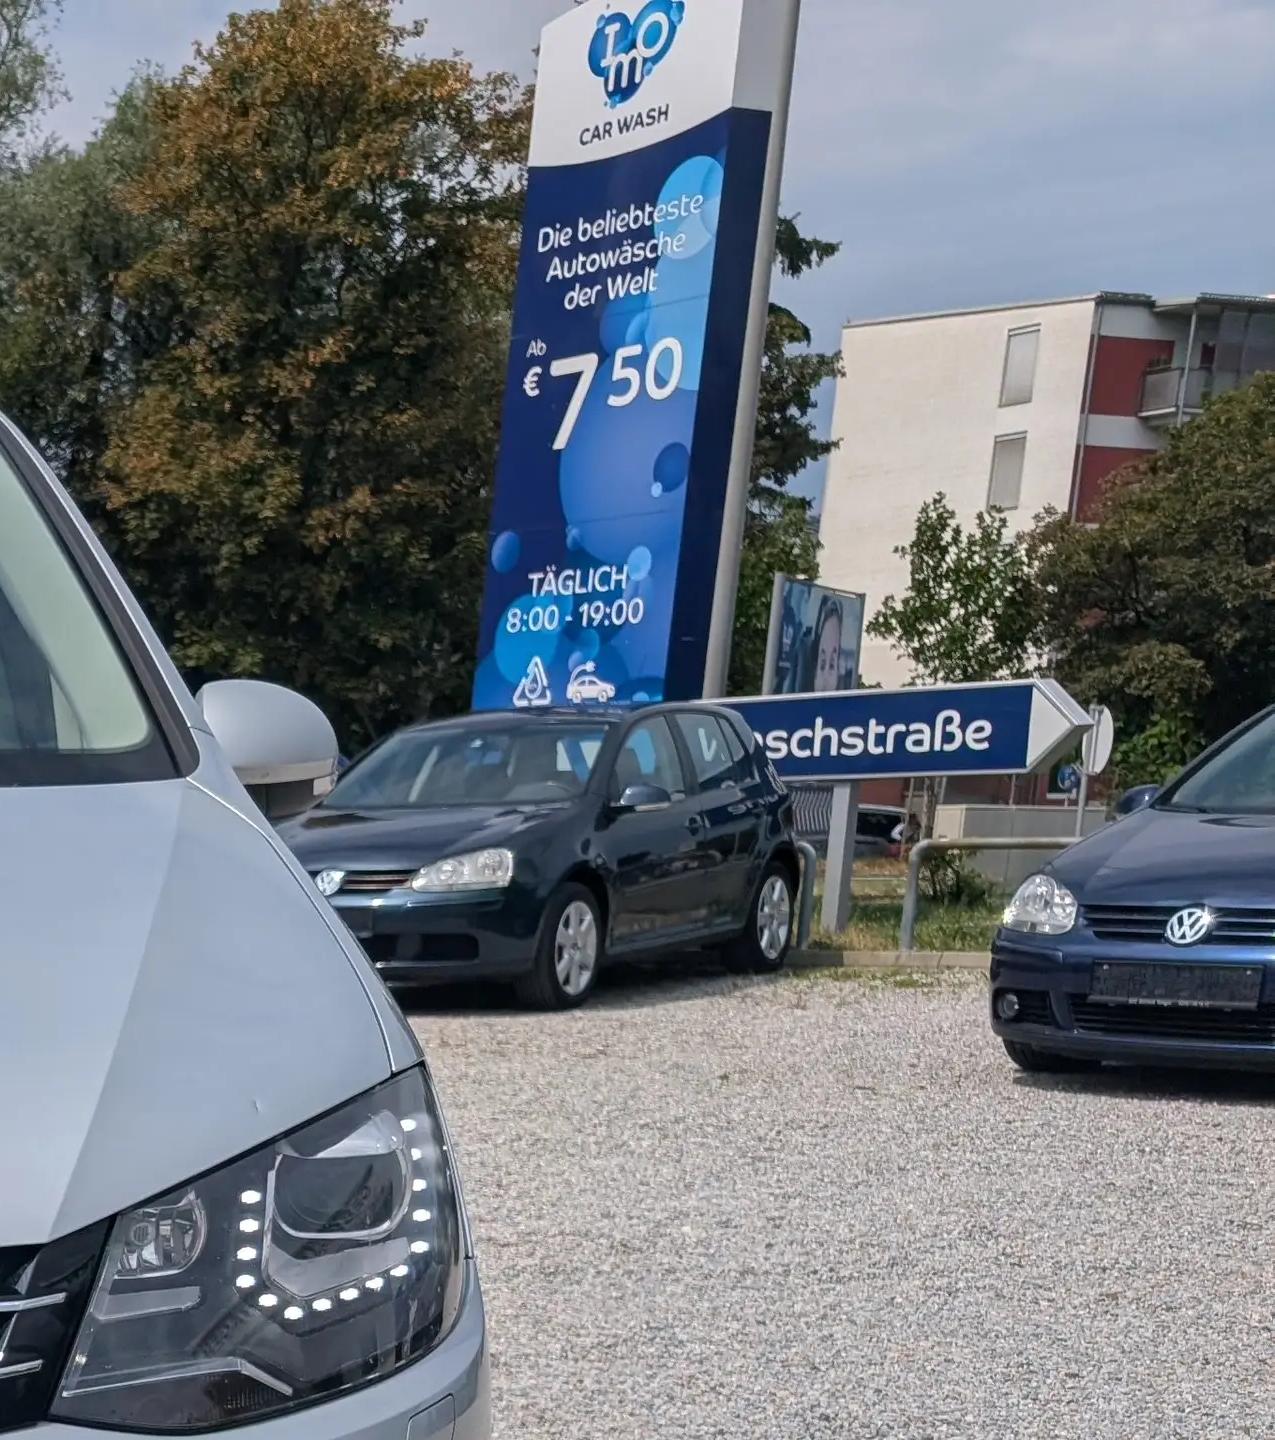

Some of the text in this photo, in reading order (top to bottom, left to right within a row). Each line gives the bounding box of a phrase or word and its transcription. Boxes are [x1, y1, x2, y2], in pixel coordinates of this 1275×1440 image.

[579, 103, 670, 146] CAR WASH
[537, 192, 704, 253] Die beliebteste
[545, 230, 686, 282] Autowäsche
[563, 267, 658, 311] der Welt
[526, 339, 547, 358] Ab
[527, 564, 630, 597] TÄGLICH
[505, 607, 559, 634] 8:00
[578, 597, 644, 628] 19:00
[752, 708, 993, 760] schstraße
